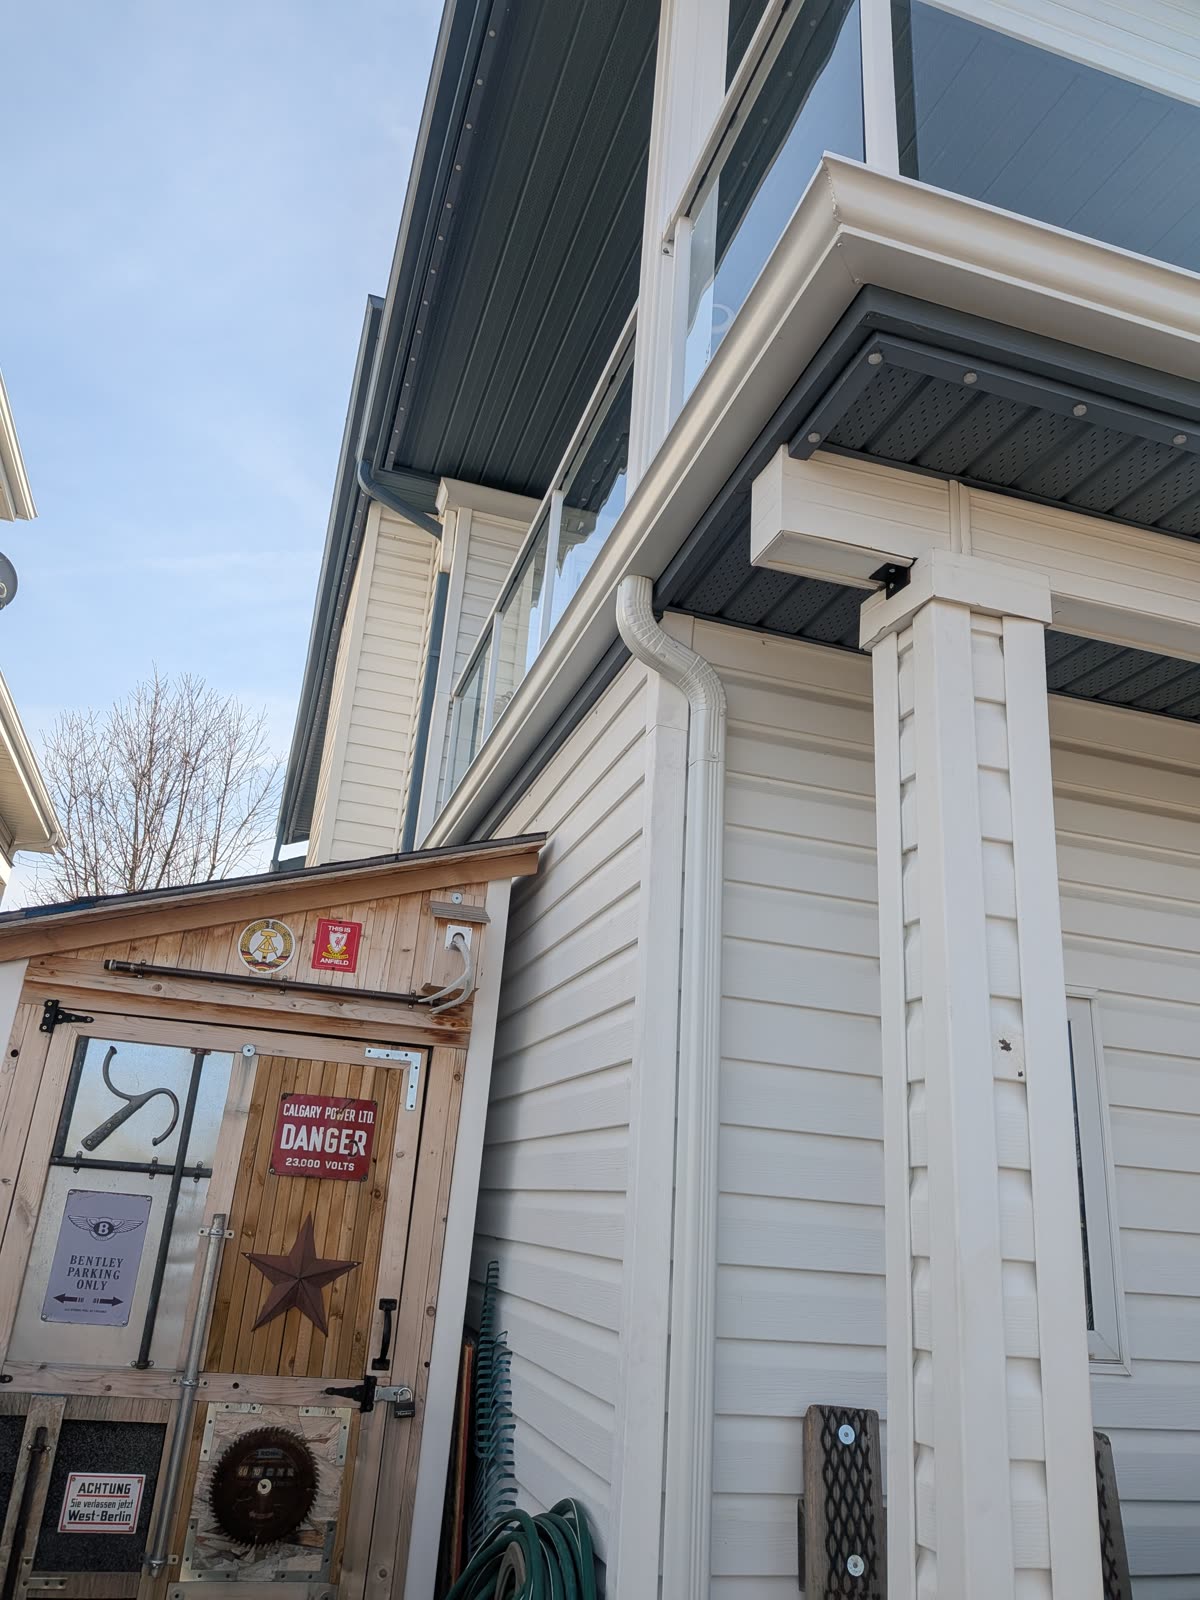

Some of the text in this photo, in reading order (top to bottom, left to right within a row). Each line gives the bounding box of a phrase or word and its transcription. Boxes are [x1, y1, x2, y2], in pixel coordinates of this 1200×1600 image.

[320, 957, 349, 966] ANFIELD
[283, 1103, 375, 1124] CALGARY POWER LTD.
[280, 1123, 368, 1156] DANGER
[285, 1157, 355, 1171] 23,000 VOLTS
[97, 1222, 110, 1234] B
[69, 1254, 124, 1268] BENTLEY
[67, 1266, 121, 1280] PARKING
[76, 1279, 108, 1291] ONLY
[78, 1482, 132, 1495] ACHTUNG
[70, 1497, 134, 1511] Sie verlassen jetzt
[68, 1509, 132, 1522] West-Berlin
